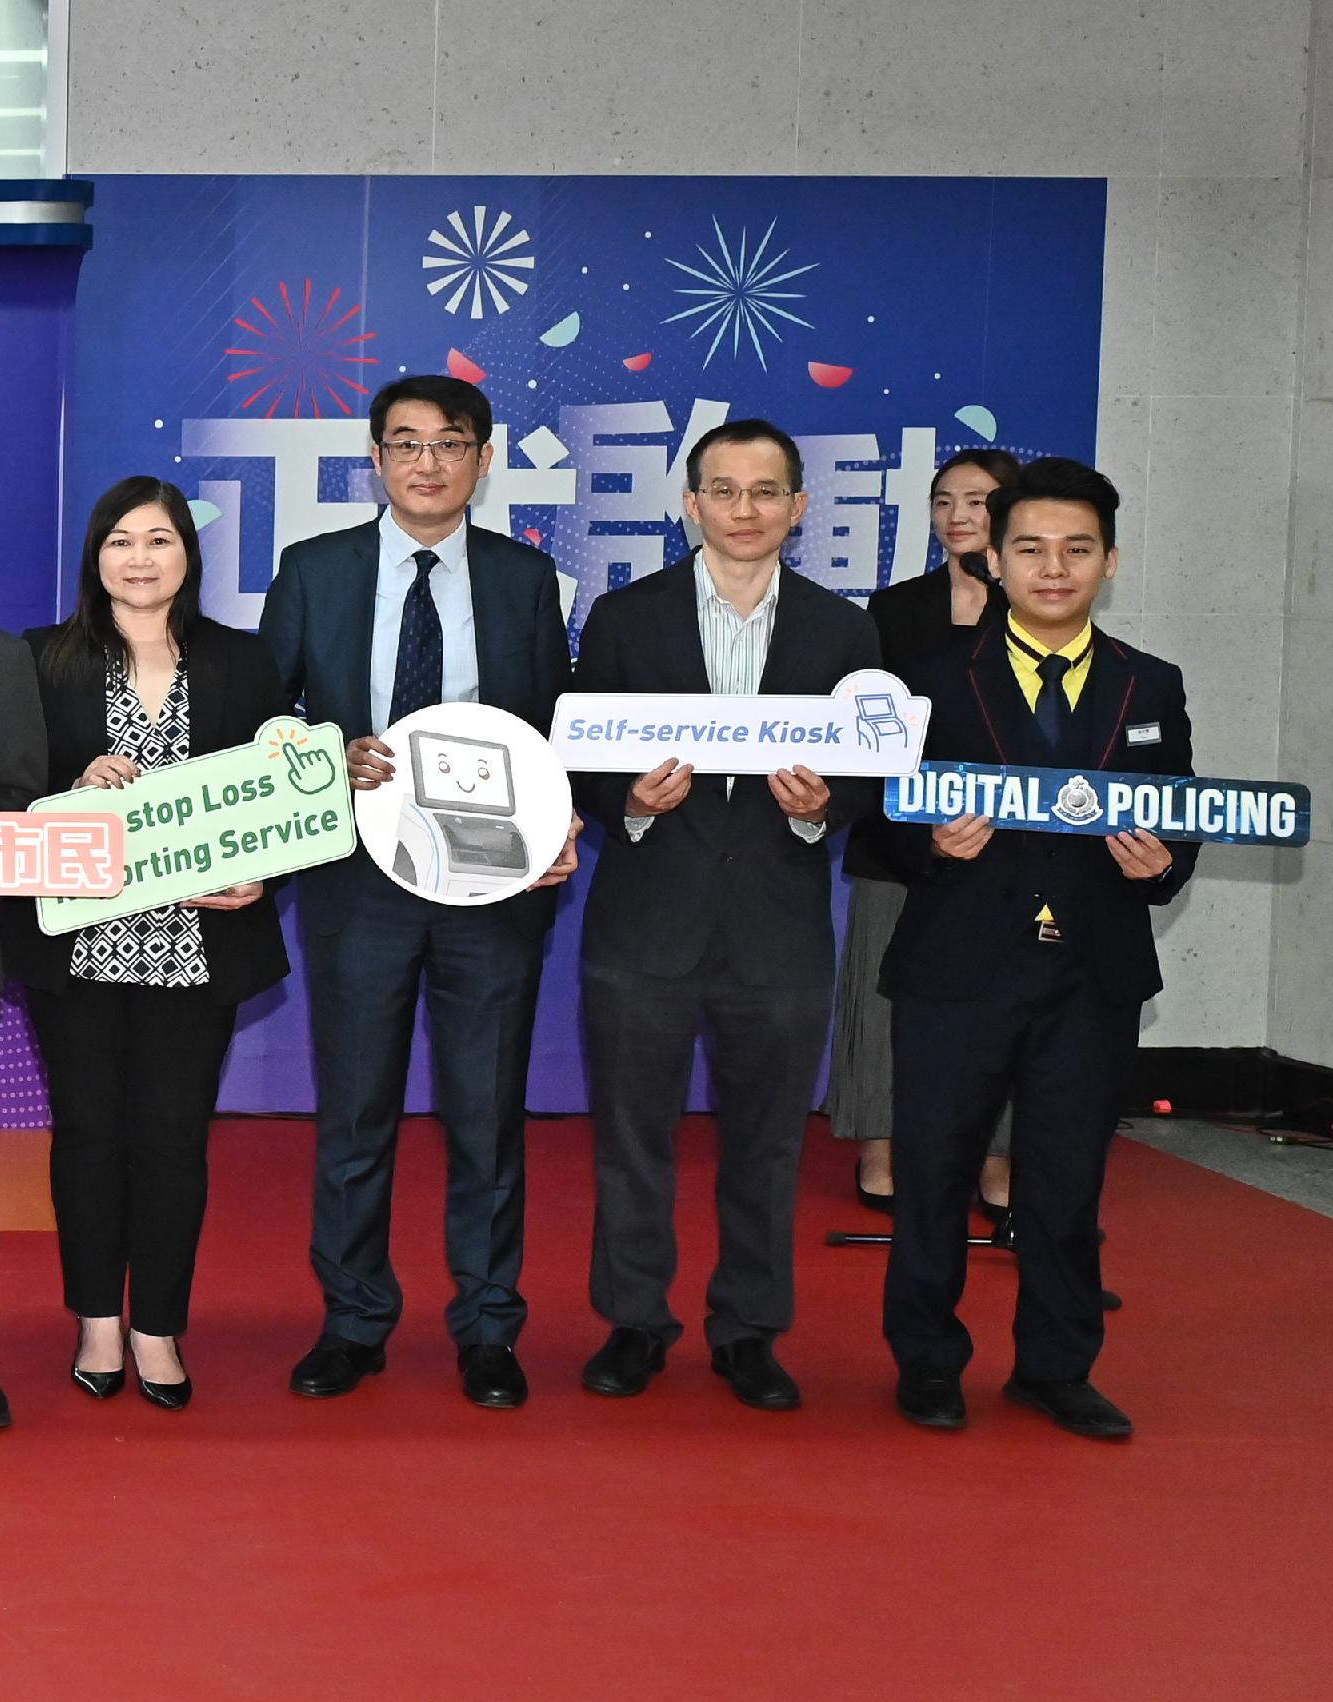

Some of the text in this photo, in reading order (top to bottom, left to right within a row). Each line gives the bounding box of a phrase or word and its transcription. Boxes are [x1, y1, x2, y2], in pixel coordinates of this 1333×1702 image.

[567, 718, 844, 745] Self-service Kiosk
[201, 774, 275, 813] Loss
[898, 771, 1297, 839] DIGITAL POLICING
[219, 809, 339, 859] Service
